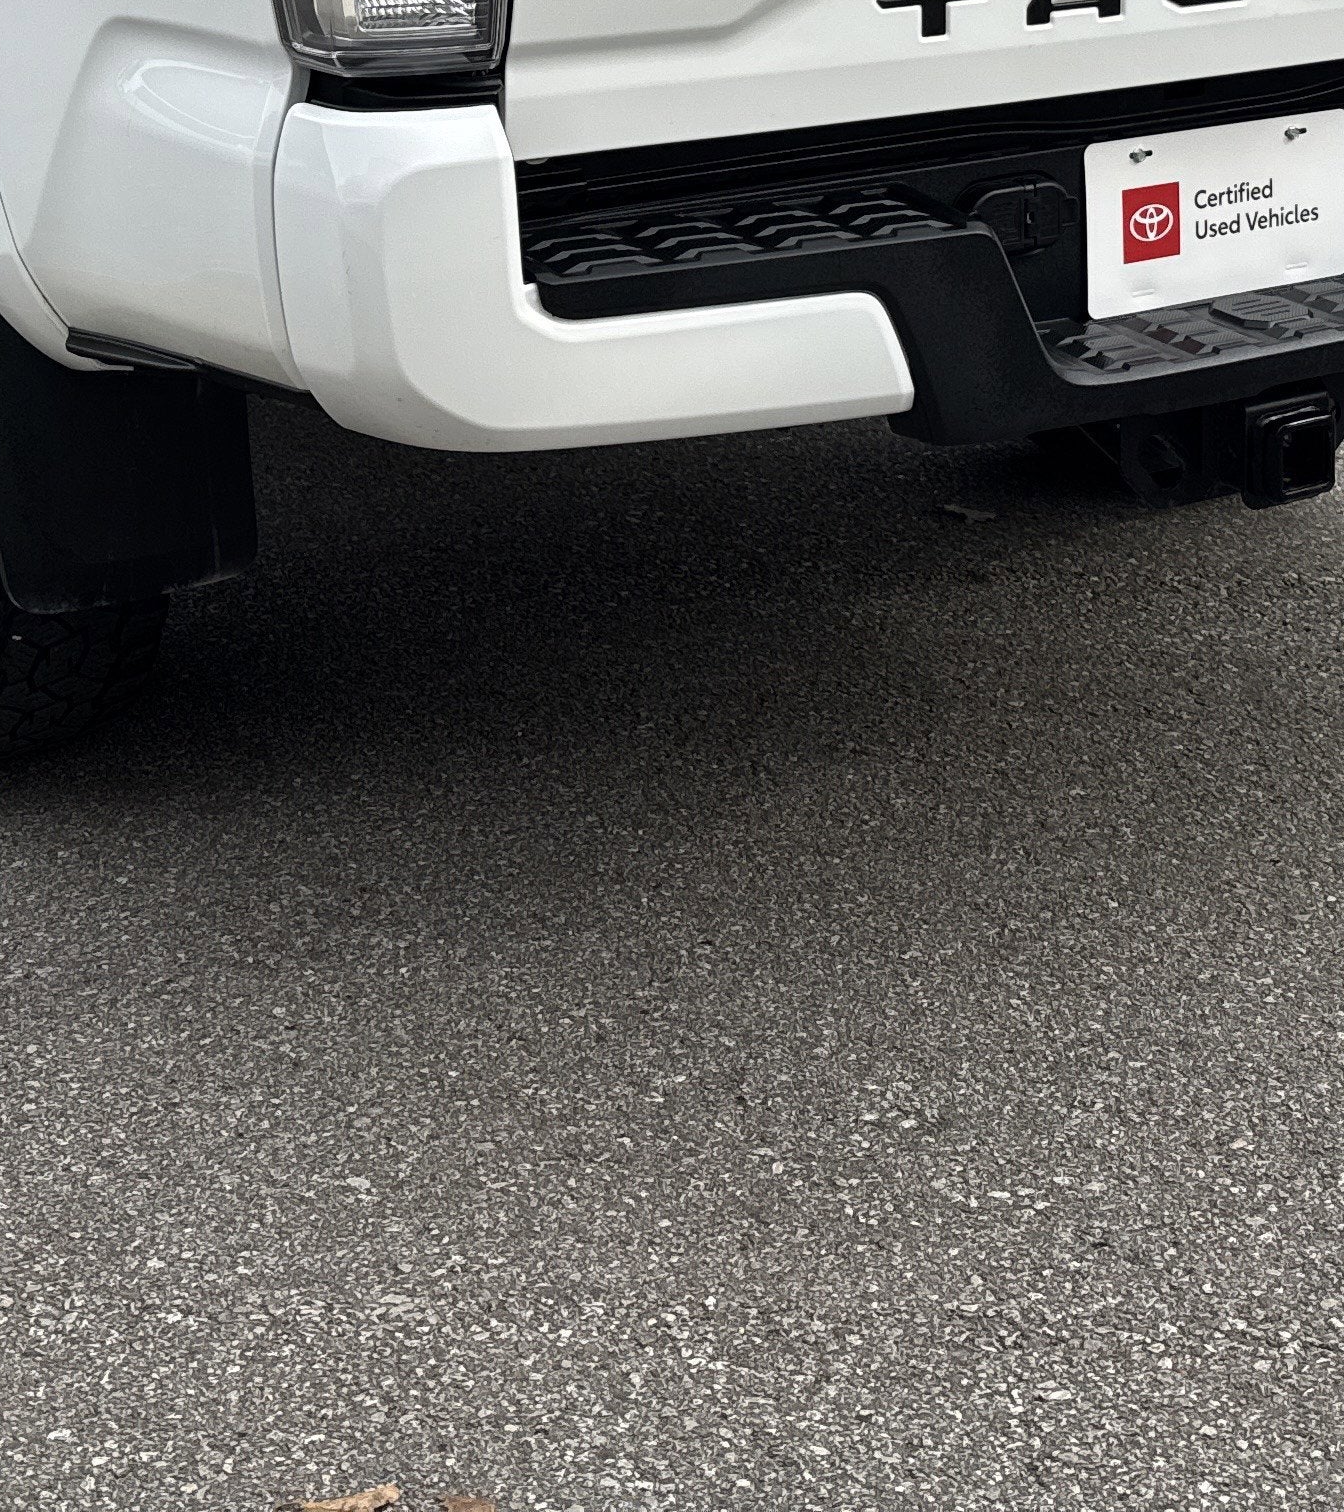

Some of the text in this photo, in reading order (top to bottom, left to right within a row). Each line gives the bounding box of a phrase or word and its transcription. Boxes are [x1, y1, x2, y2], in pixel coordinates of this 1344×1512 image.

[1194, 178, 1273, 210] Certified
[1195, 204, 1319, 240] Used Vehicles
